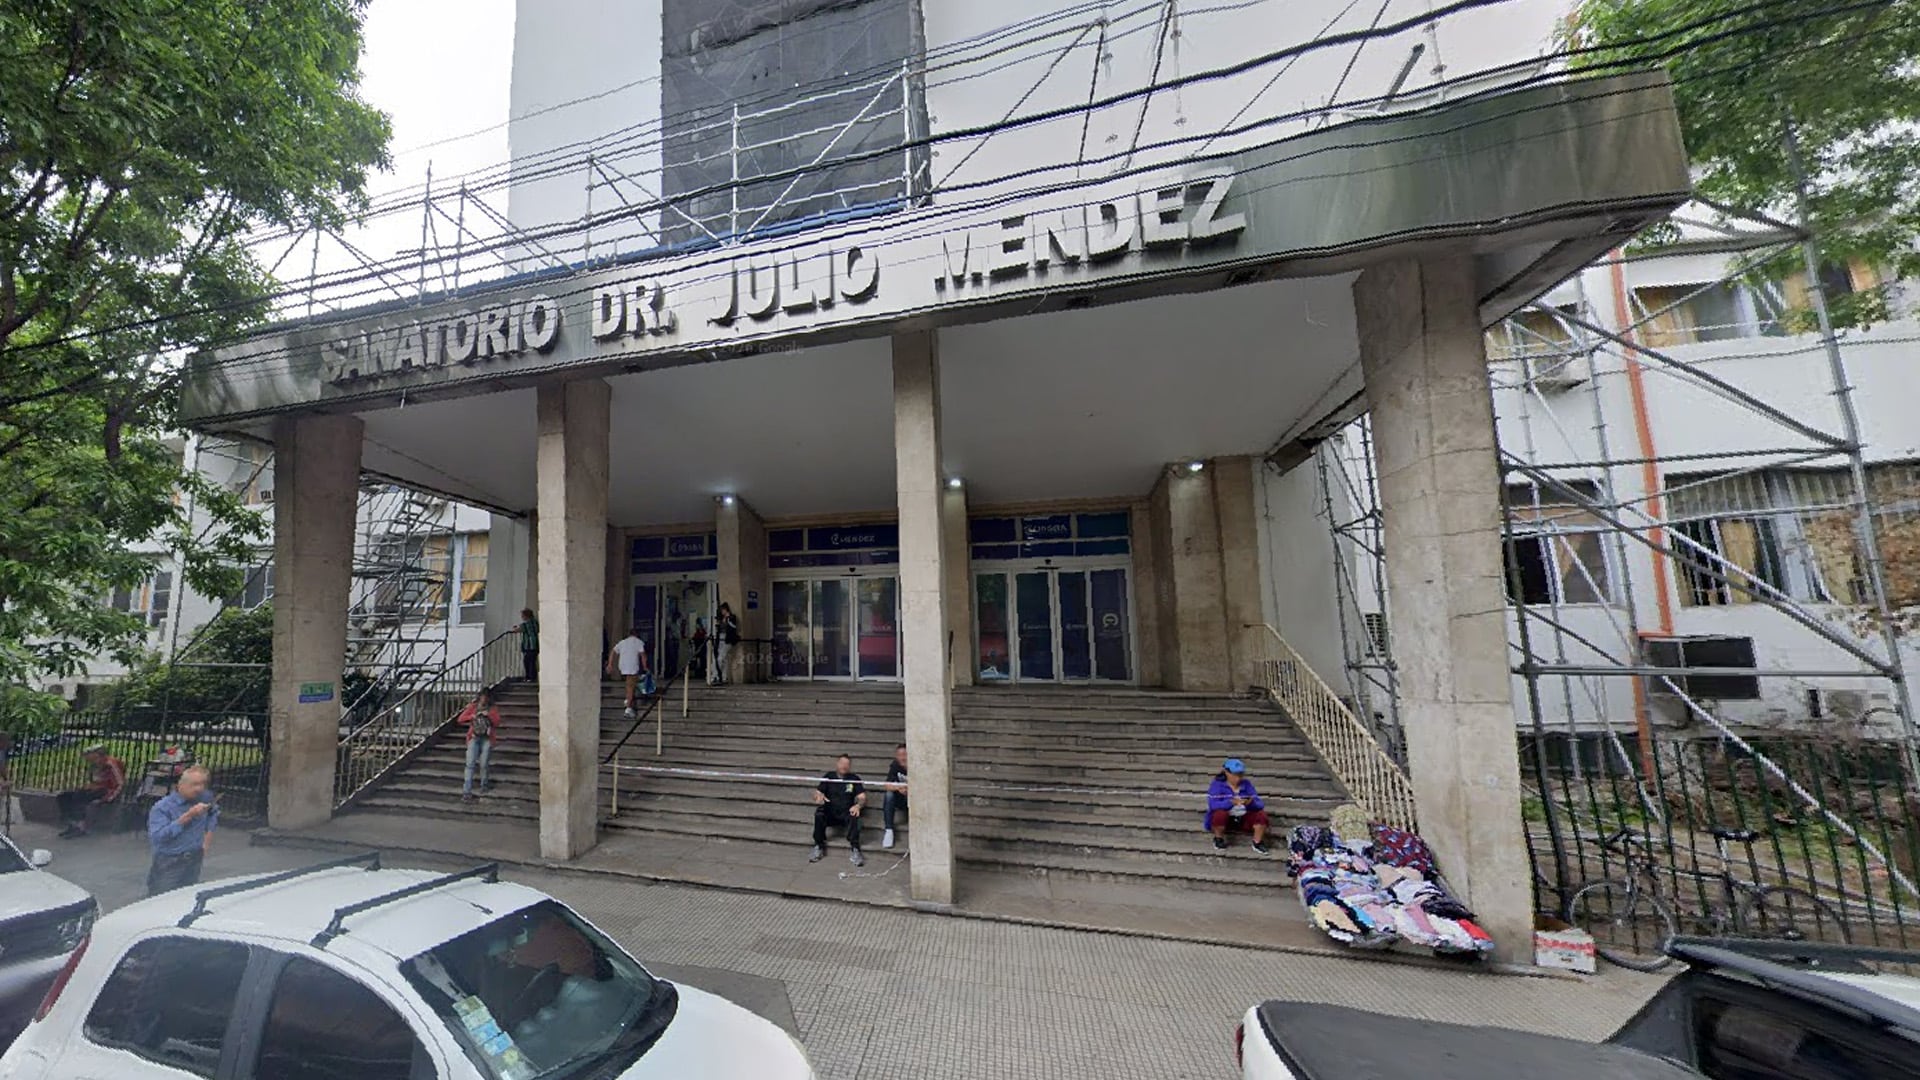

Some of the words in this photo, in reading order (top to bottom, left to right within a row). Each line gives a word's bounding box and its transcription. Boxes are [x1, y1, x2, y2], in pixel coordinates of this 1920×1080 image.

[320, 295, 562, 385] SANATORIO
[592, 280, 677, 341] DR.
[706, 243, 881, 326] JULIO
[933, 166, 1247, 289] MENDEZ
